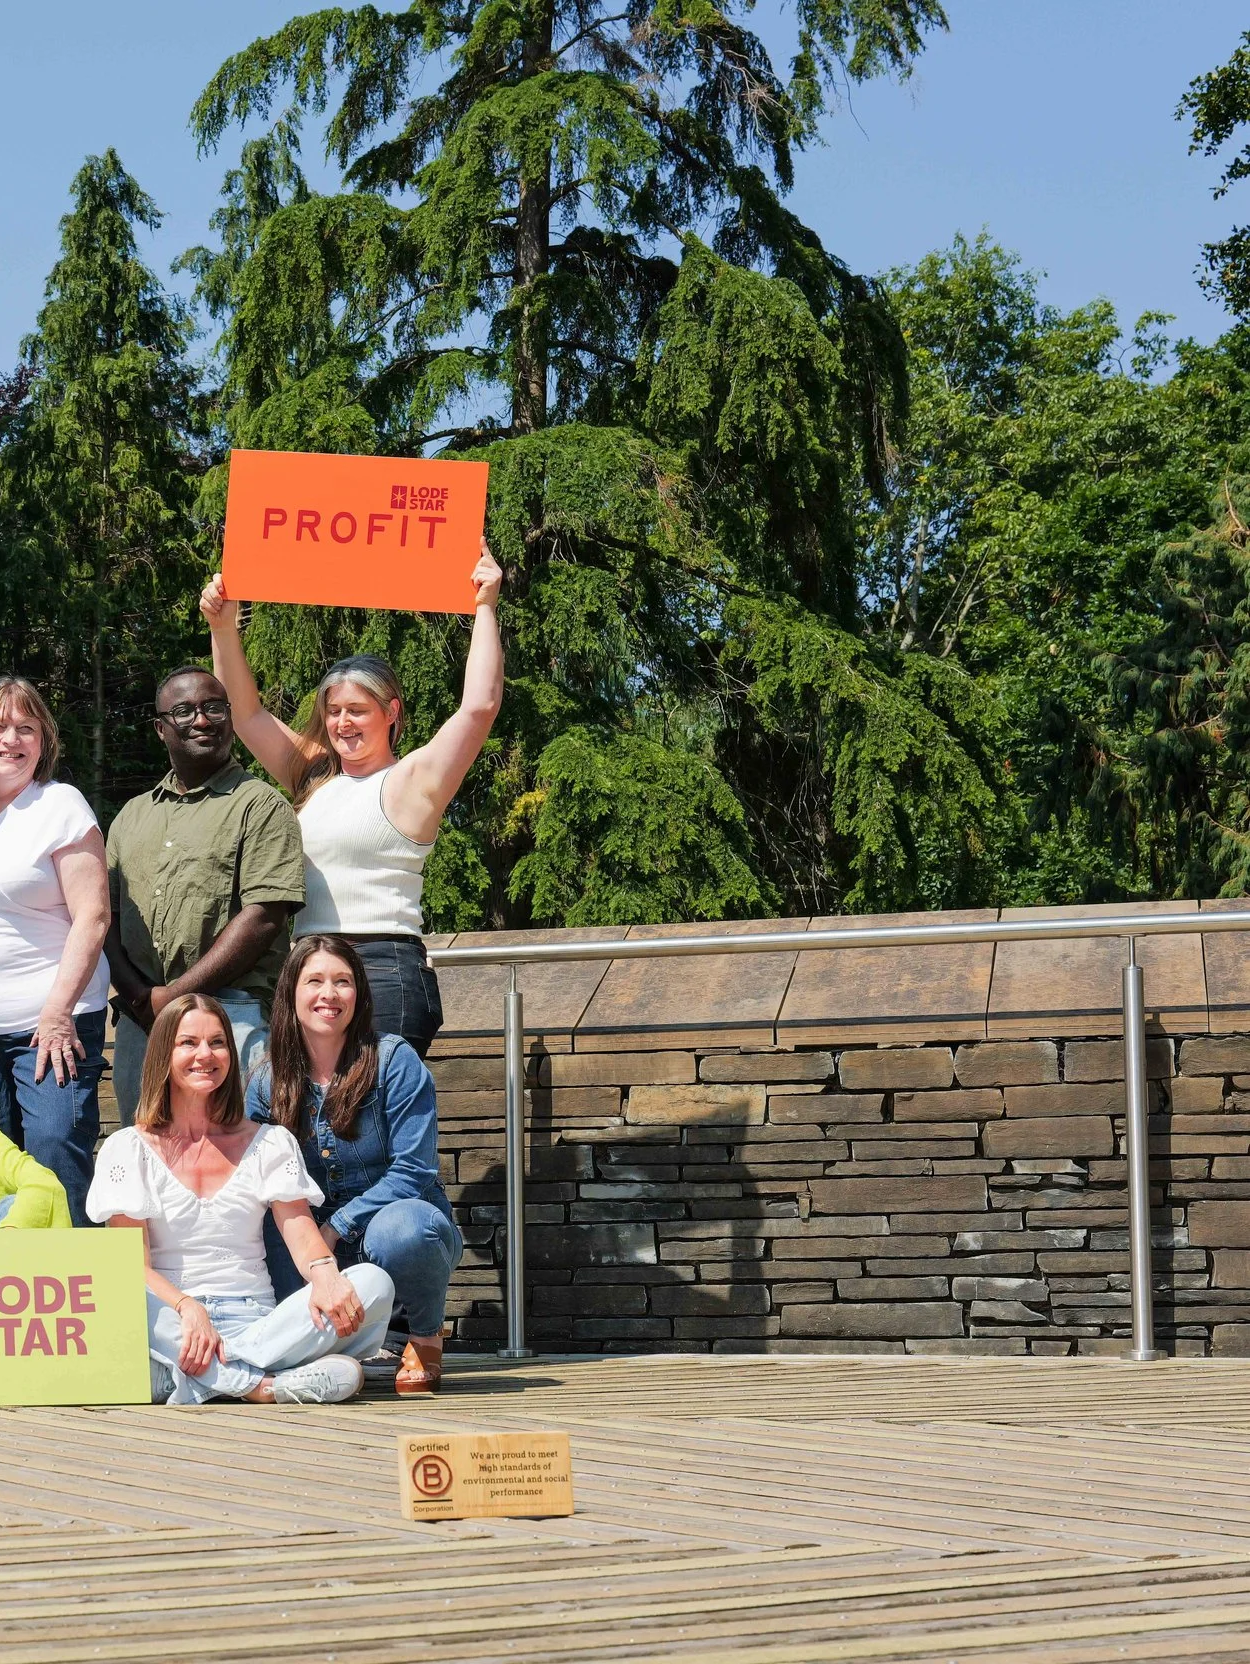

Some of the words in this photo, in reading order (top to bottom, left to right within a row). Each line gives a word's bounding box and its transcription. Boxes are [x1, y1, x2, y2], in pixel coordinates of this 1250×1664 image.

[409, 486, 449, 500] LODE
[409, 498, 445, 511] STAR
[262, 508, 447, 549] PROFIT
[409, 1443, 450, 1452] Certified
[502, 1450, 526, 1460] proud
[538, 1450, 558, 1458] meet
[478, 1463, 498, 1473] high
[500, 1463, 541, 1471] standards
[542, 1462, 551, 1470] of
[462, 1475, 525, 1485] environmental
[526, 1475, 542, 1483] and
[544, 1474, 569, 1482] social
[490, 1488, 543, 1498] performance
[413, 1505, 454, 1513] Corporation
